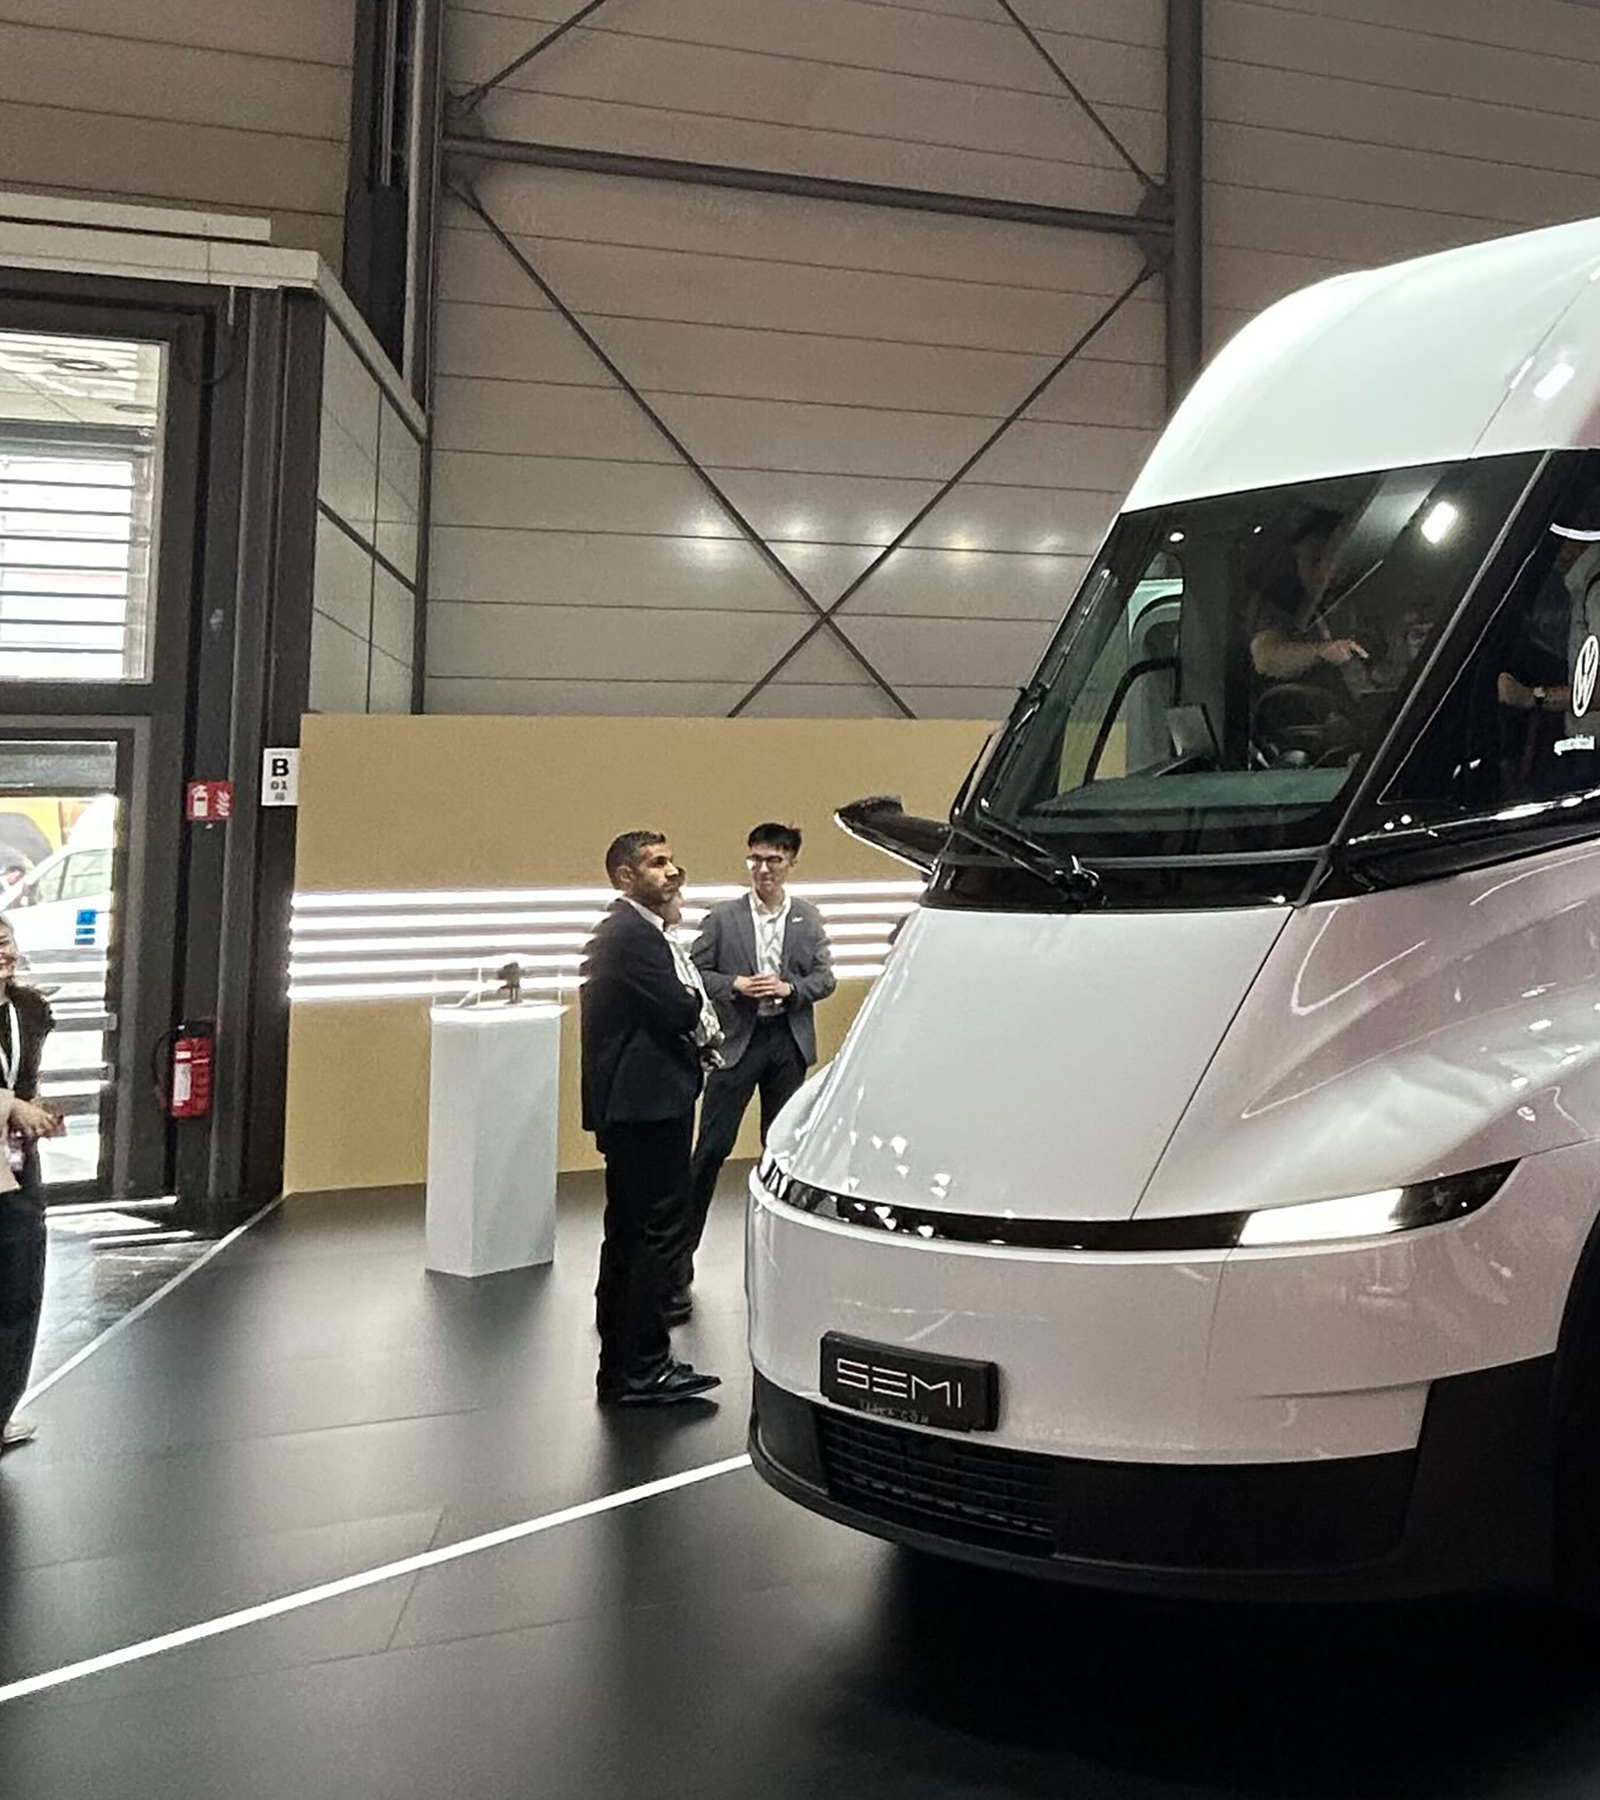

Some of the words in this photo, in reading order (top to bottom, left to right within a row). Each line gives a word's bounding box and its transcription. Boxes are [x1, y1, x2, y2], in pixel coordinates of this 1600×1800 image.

[272, 758, 289, 776] B
[270, 780, 288, 791] 01
[837, 1357, 962, 1408] SEMI
